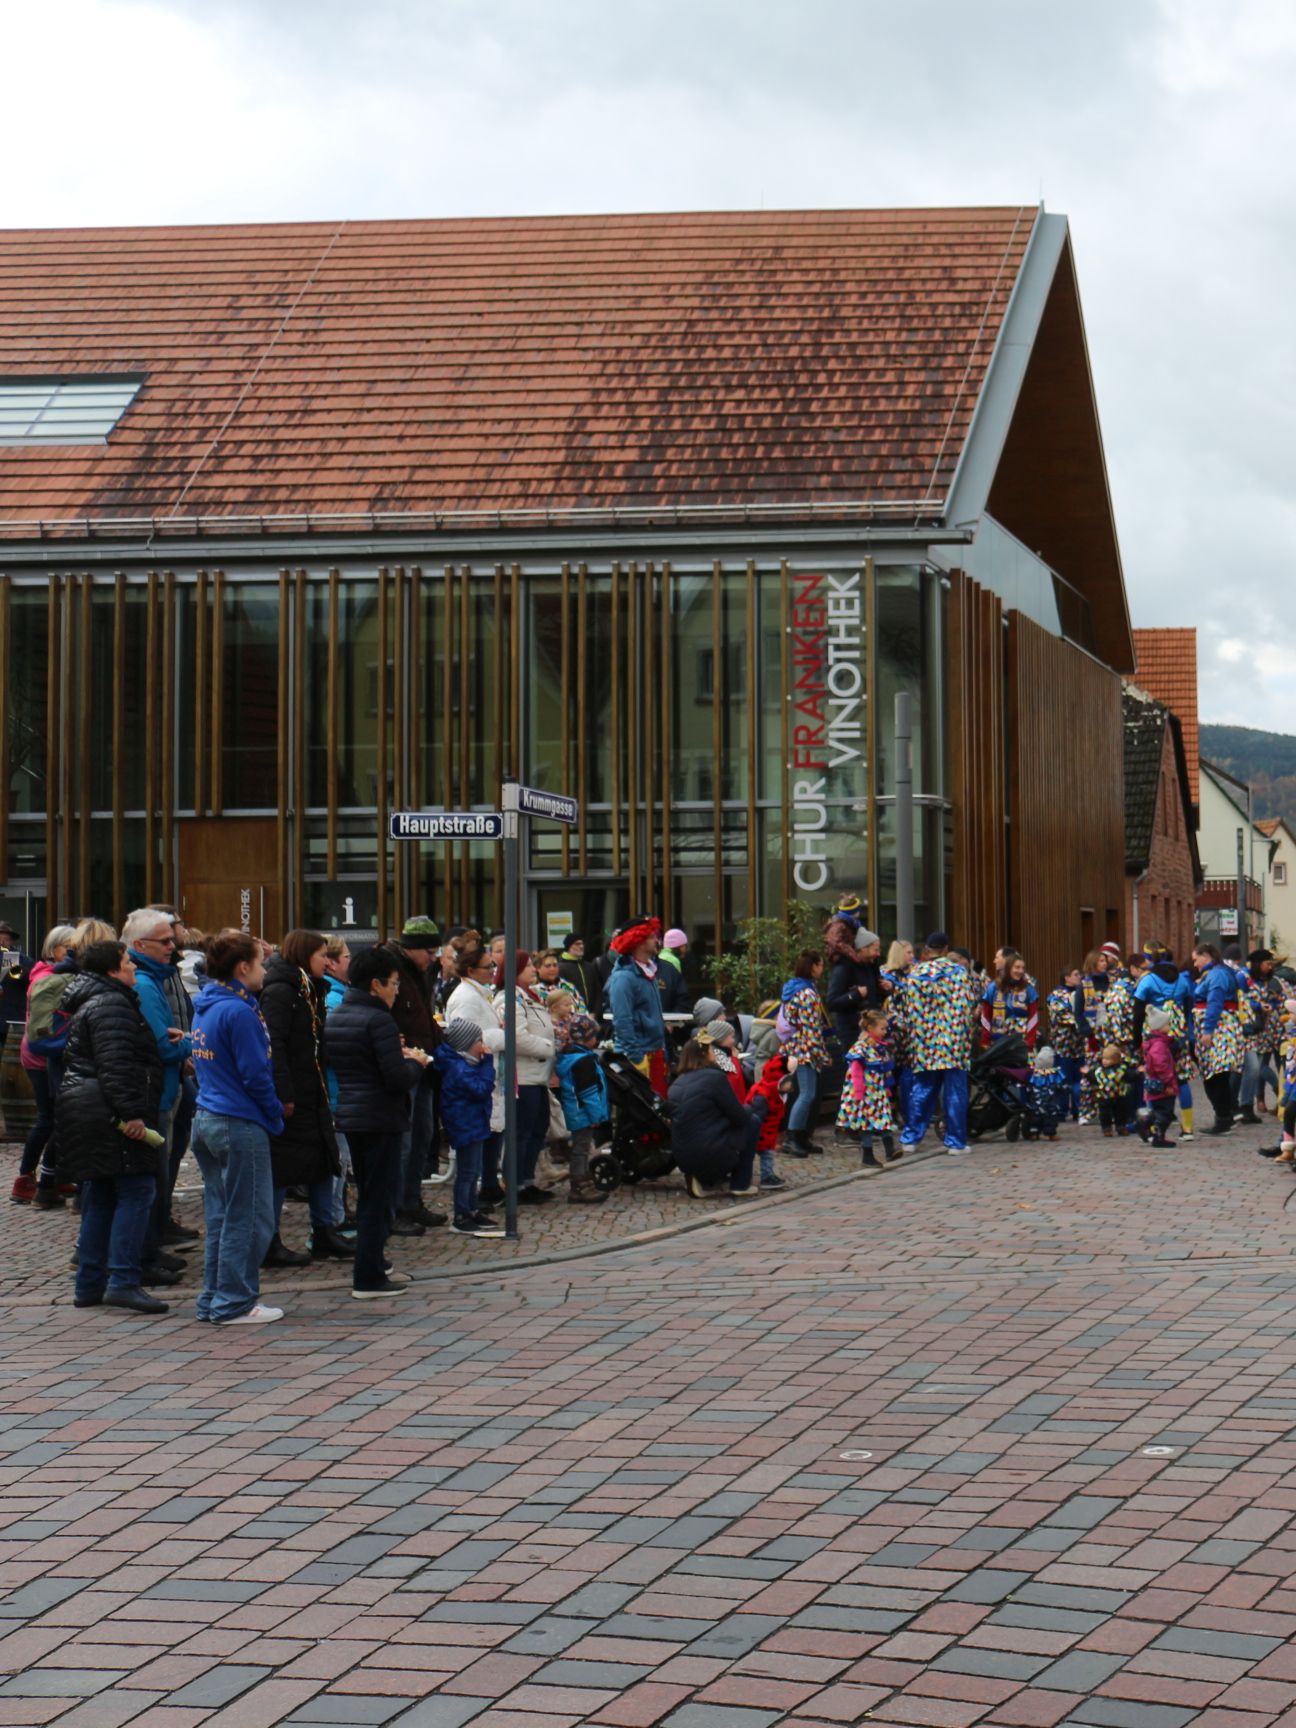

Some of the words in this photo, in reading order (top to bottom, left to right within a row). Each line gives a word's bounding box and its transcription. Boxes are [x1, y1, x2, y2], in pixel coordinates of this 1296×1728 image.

[792, 574, 825, 769] FRANKEN
[827, 572, 861, 768] VINOTHEK
[400, 815, 495, 838] Hauptstraße
[523, 788, 573, 817] Krummgasse
[793, 777, 827, 891] CHUR
[240, 888, 251, 935] INOTHEK
